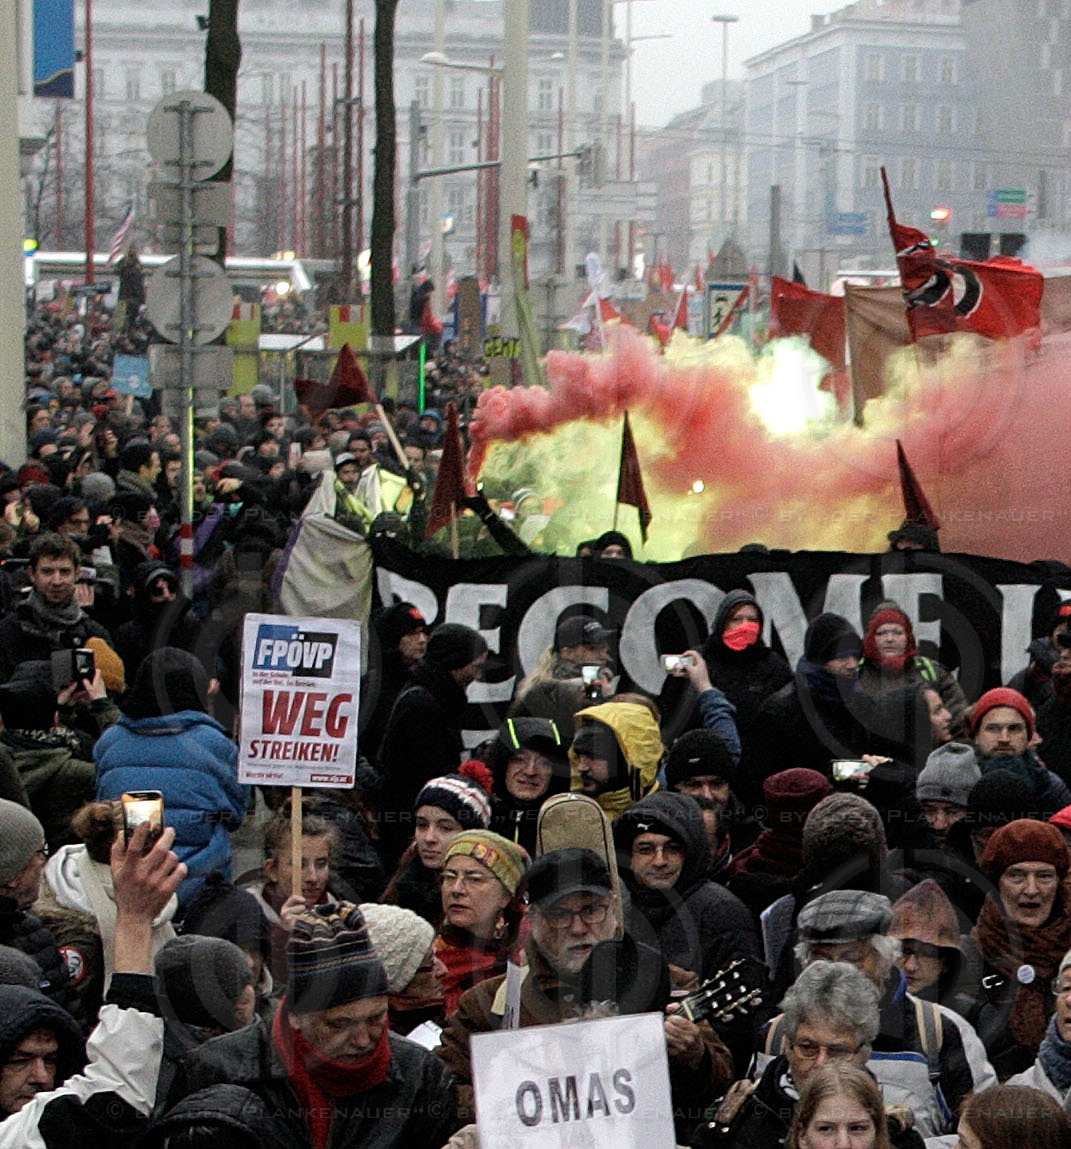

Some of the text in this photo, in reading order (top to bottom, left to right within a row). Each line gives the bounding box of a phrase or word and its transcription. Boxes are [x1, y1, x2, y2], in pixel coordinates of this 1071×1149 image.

[256, 633, 333, 669] FPÖVP
[262, 689, 353, 739] WEG
[248, 739, 339, 763] STREIKEN!
[516, 1068, 636, 1127] OMAS
